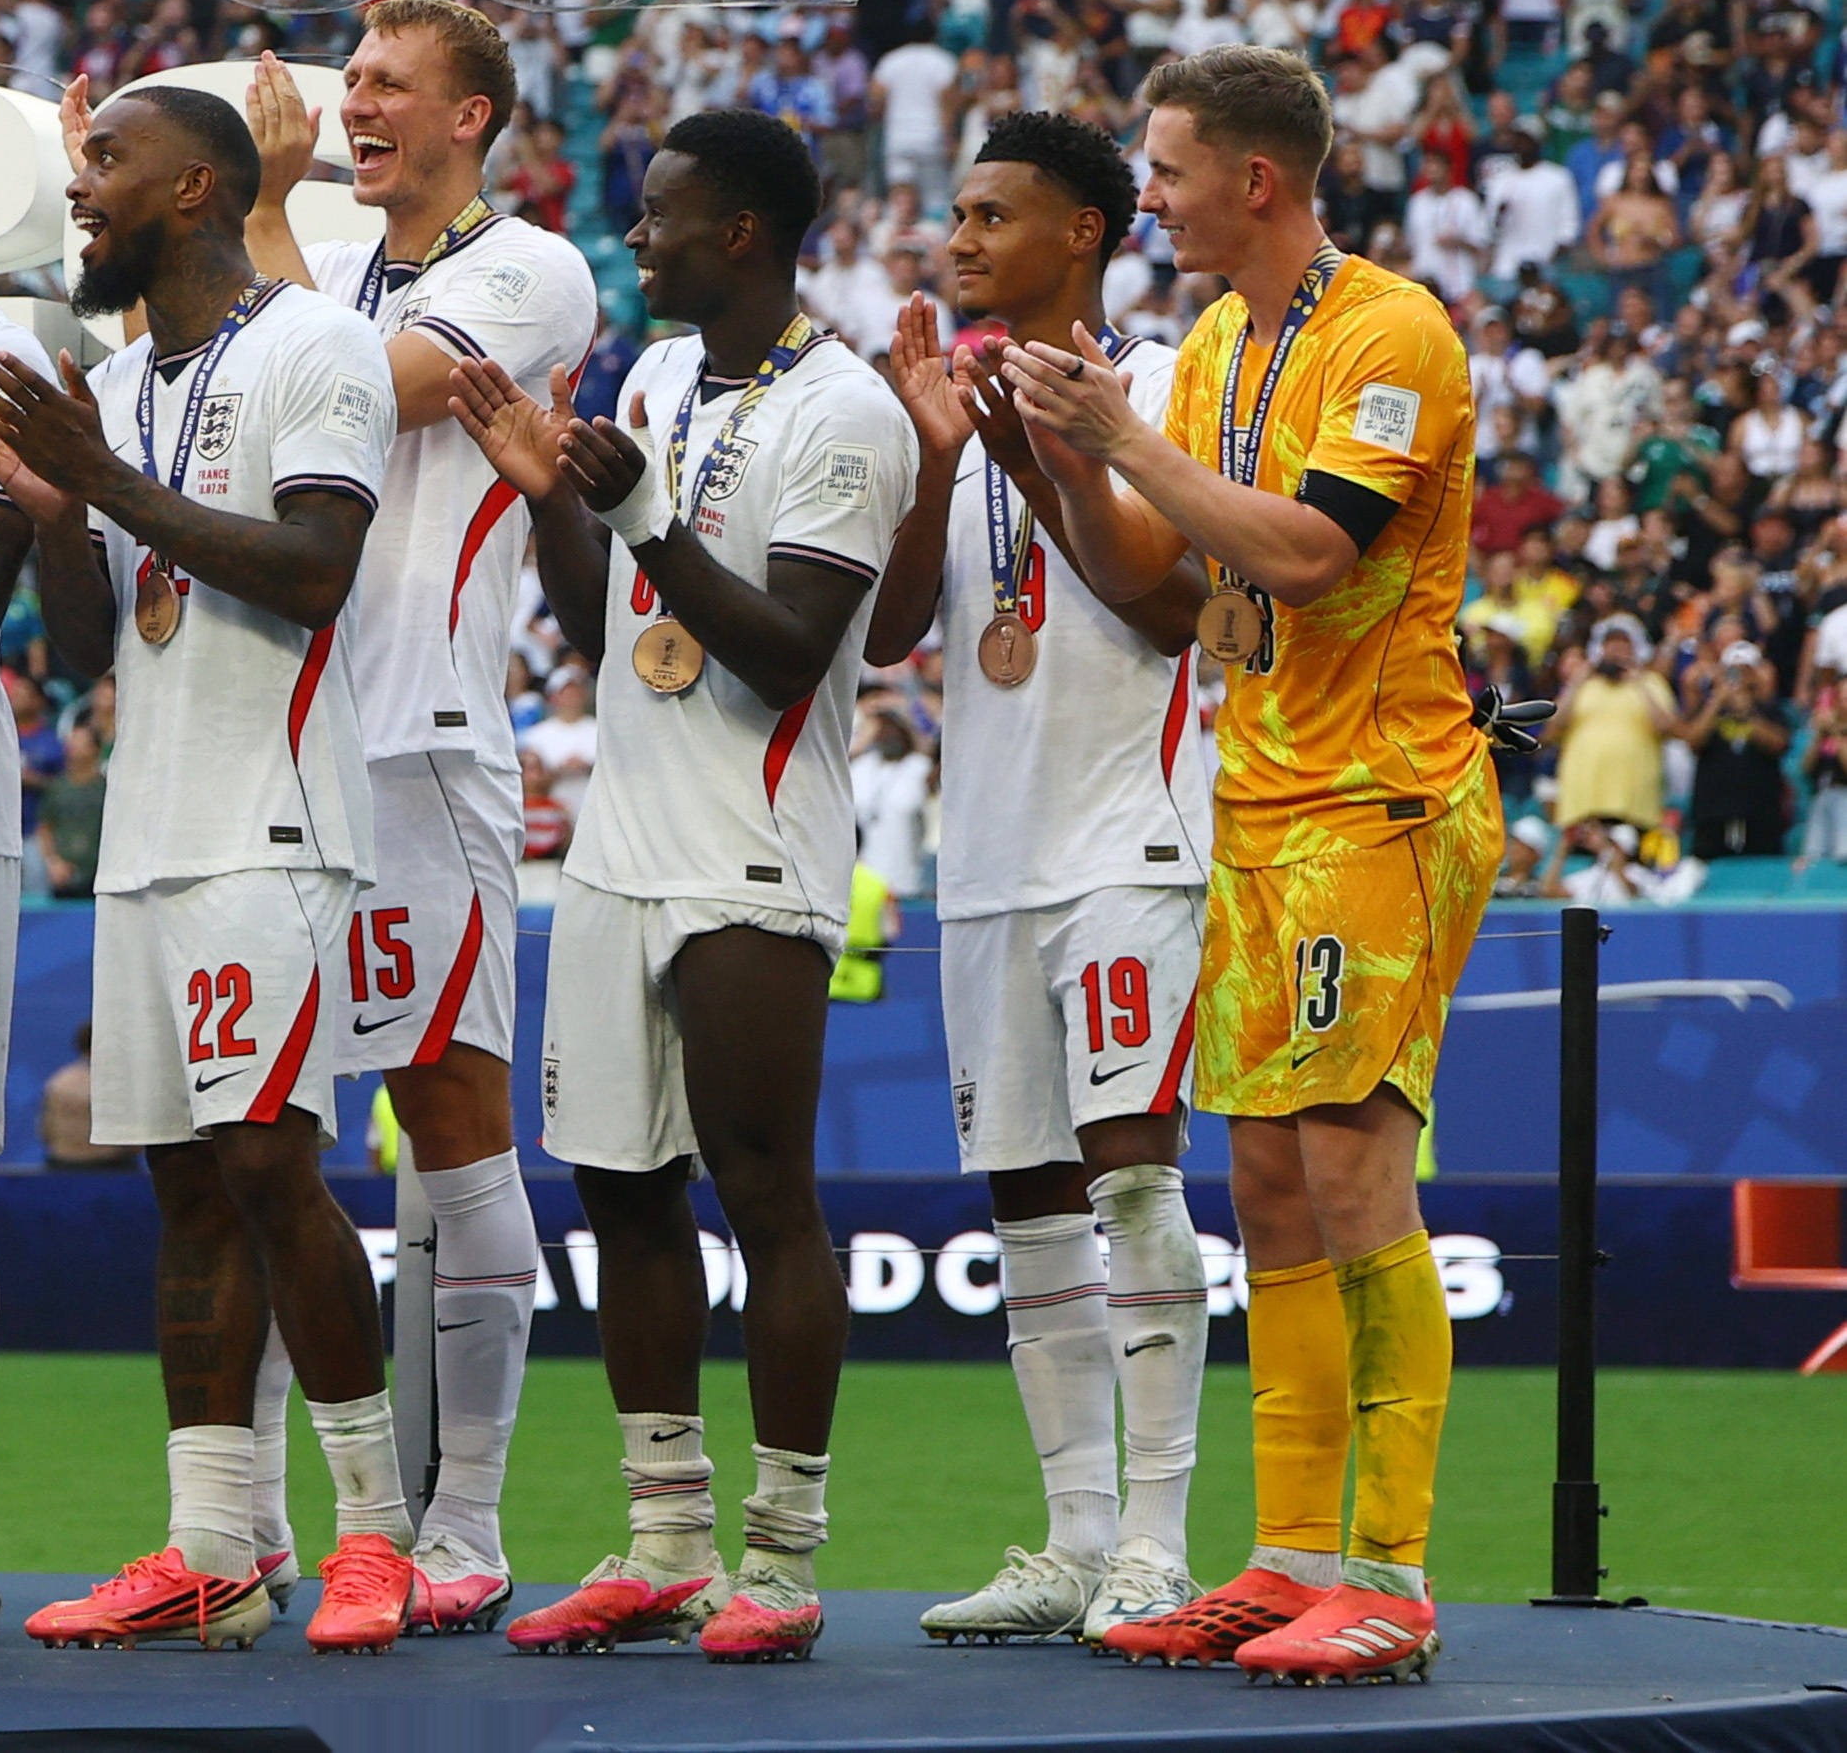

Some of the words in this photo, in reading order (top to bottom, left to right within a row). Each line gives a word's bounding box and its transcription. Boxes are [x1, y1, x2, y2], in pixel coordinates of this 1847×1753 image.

[1271, 325, 1296, 372] 2026
[340, 382, 373, 402] FOOTBALL
[1226, 354, 1241, 404] WORLD
[1261, 371, 1276, 401] CUP
[173, 447, 185, 477] FIFA
[181, 398, 199, 447] WORLD
[192, 373, 208, 398] CUP
[203, 331, 230, 373] 2026
[337, 392, 371, 415] UNITES
[1369, 405, 1407, 425] UNITES
[1372, 394, 1408, 411] FOOTBALL
[1223, 405, 1232, 432] CUP
[1250, 401, 1267, 450] WORLD
[197, 468, 231, 481] FRANCE
[831, 465, 868, 480] UNITES
[832, 453, 868, 467] FOOTBALL
[1244, 450, 1257, 481] FIFA
[990, 461, 1002, 497] ORLD
[992, 497, 1004, 523] CUP
[994, 525, 1007, 569] 2026
[348, 906, 416, 1003] 15
[1294, 935, 1345, 1036] 13
[187, 962, 257, 1065] 22
[1080, 957, 1152, 1054] 19
